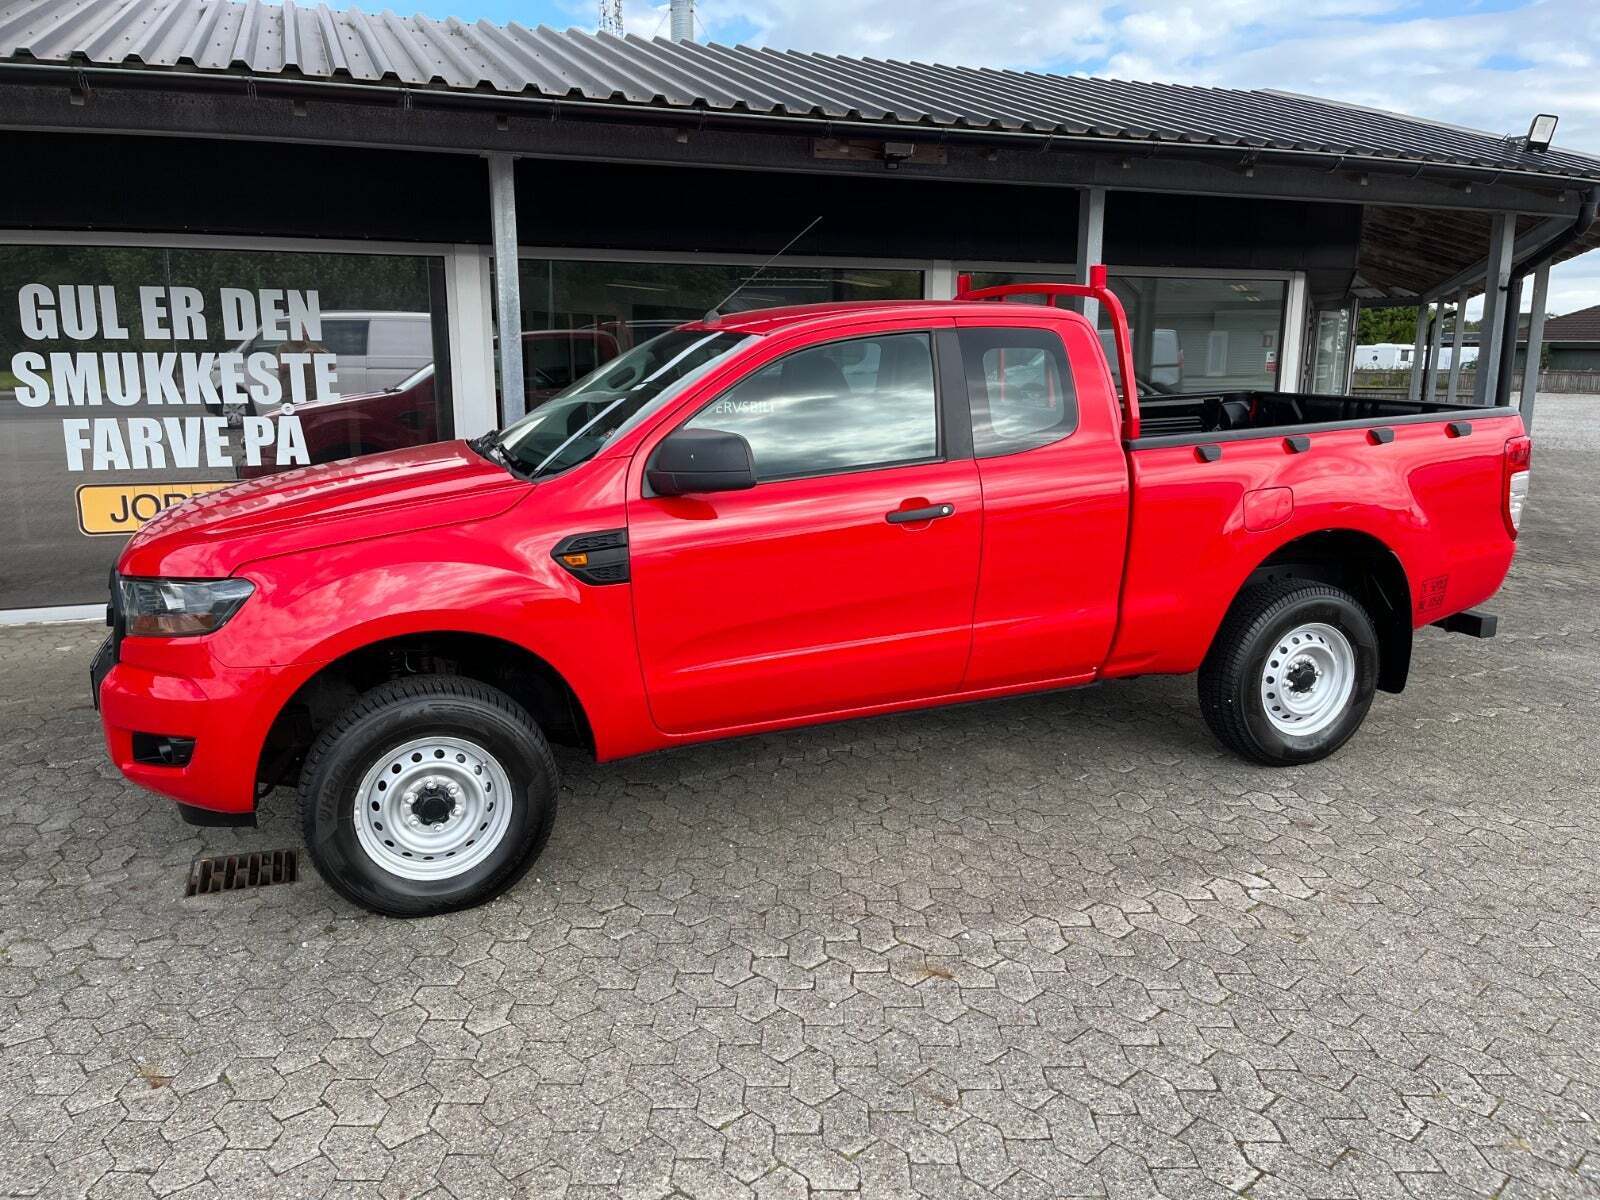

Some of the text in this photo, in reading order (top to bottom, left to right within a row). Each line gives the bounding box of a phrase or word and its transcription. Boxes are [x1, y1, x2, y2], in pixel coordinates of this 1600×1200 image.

[18, 283, 322, 341] GUL ER DEN
[11, 351, 341, 407] SMUKKESTE
[63, 402, 311, 471] FARVE PÅ
